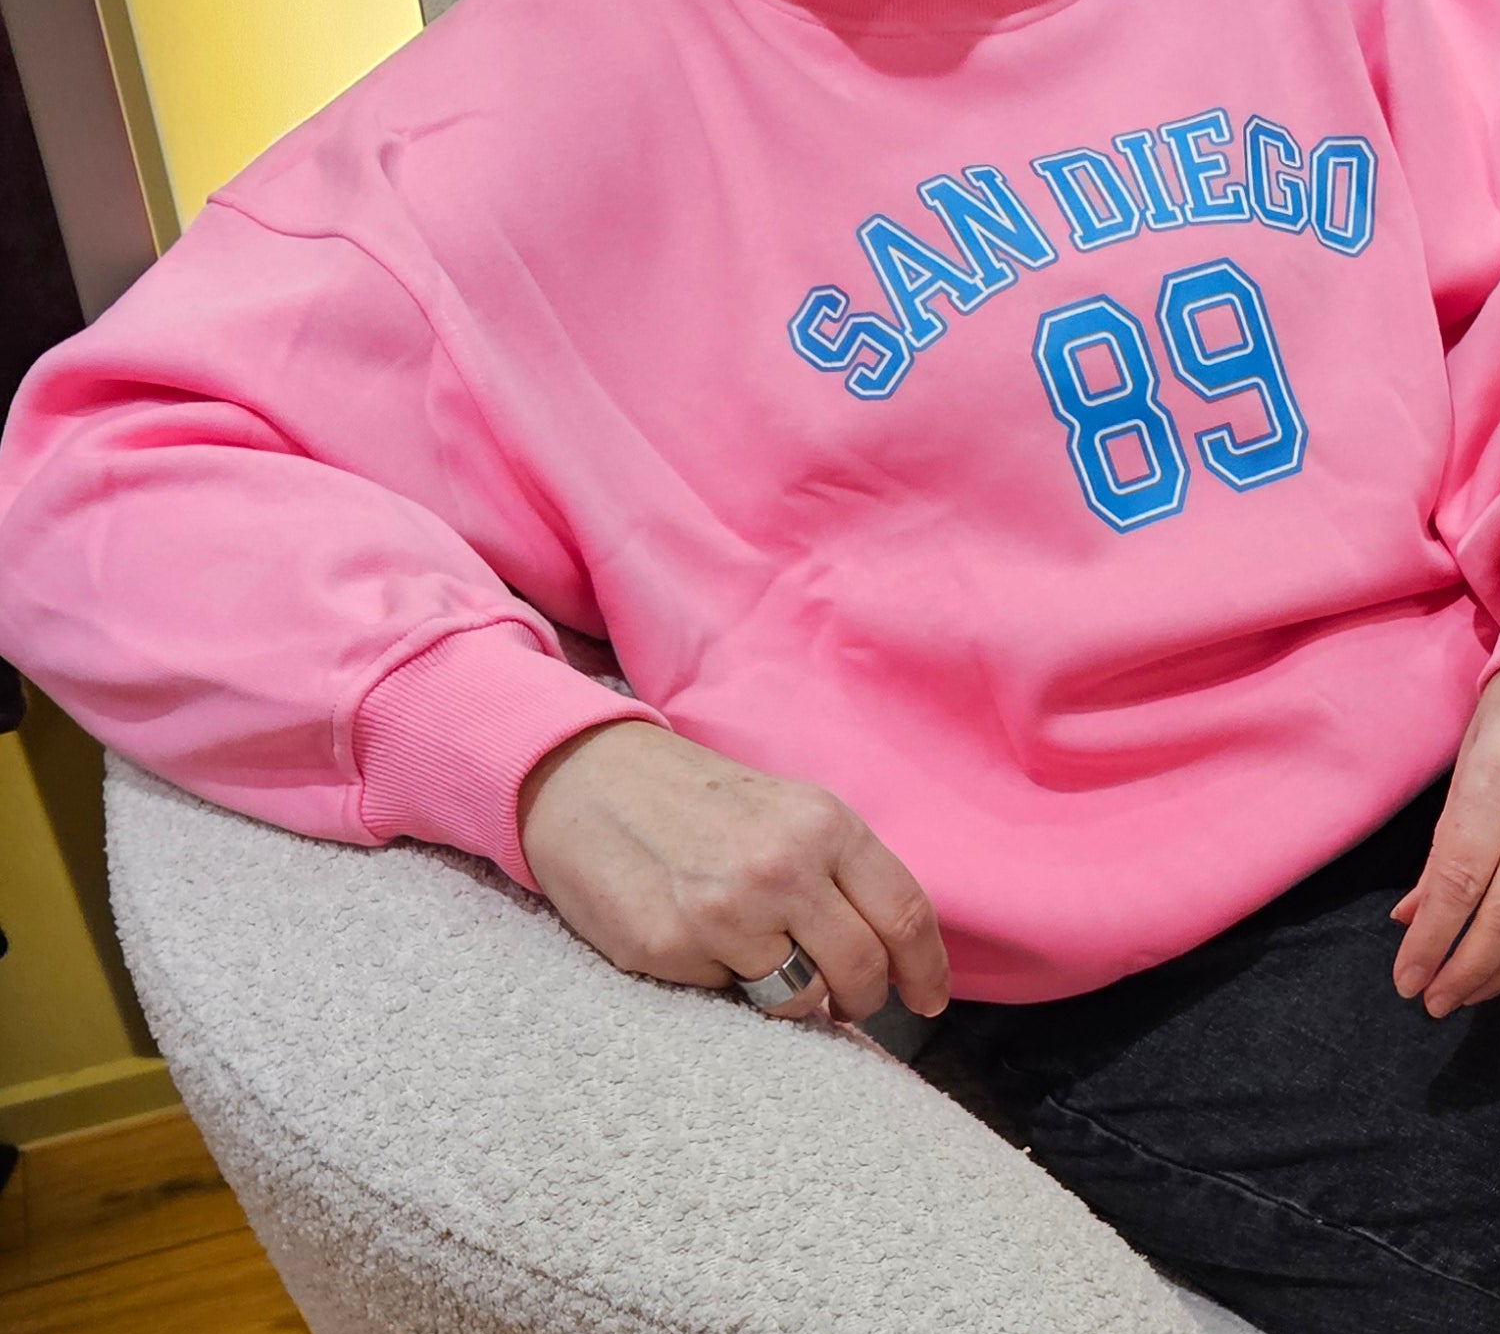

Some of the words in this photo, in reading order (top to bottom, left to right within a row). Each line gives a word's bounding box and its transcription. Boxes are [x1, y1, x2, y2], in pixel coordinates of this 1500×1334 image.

[788, 166, 1058, 400] SAN
[1031, 107, 1376, 257] DIEGO
[1032, 257, 1309, 534] 89
